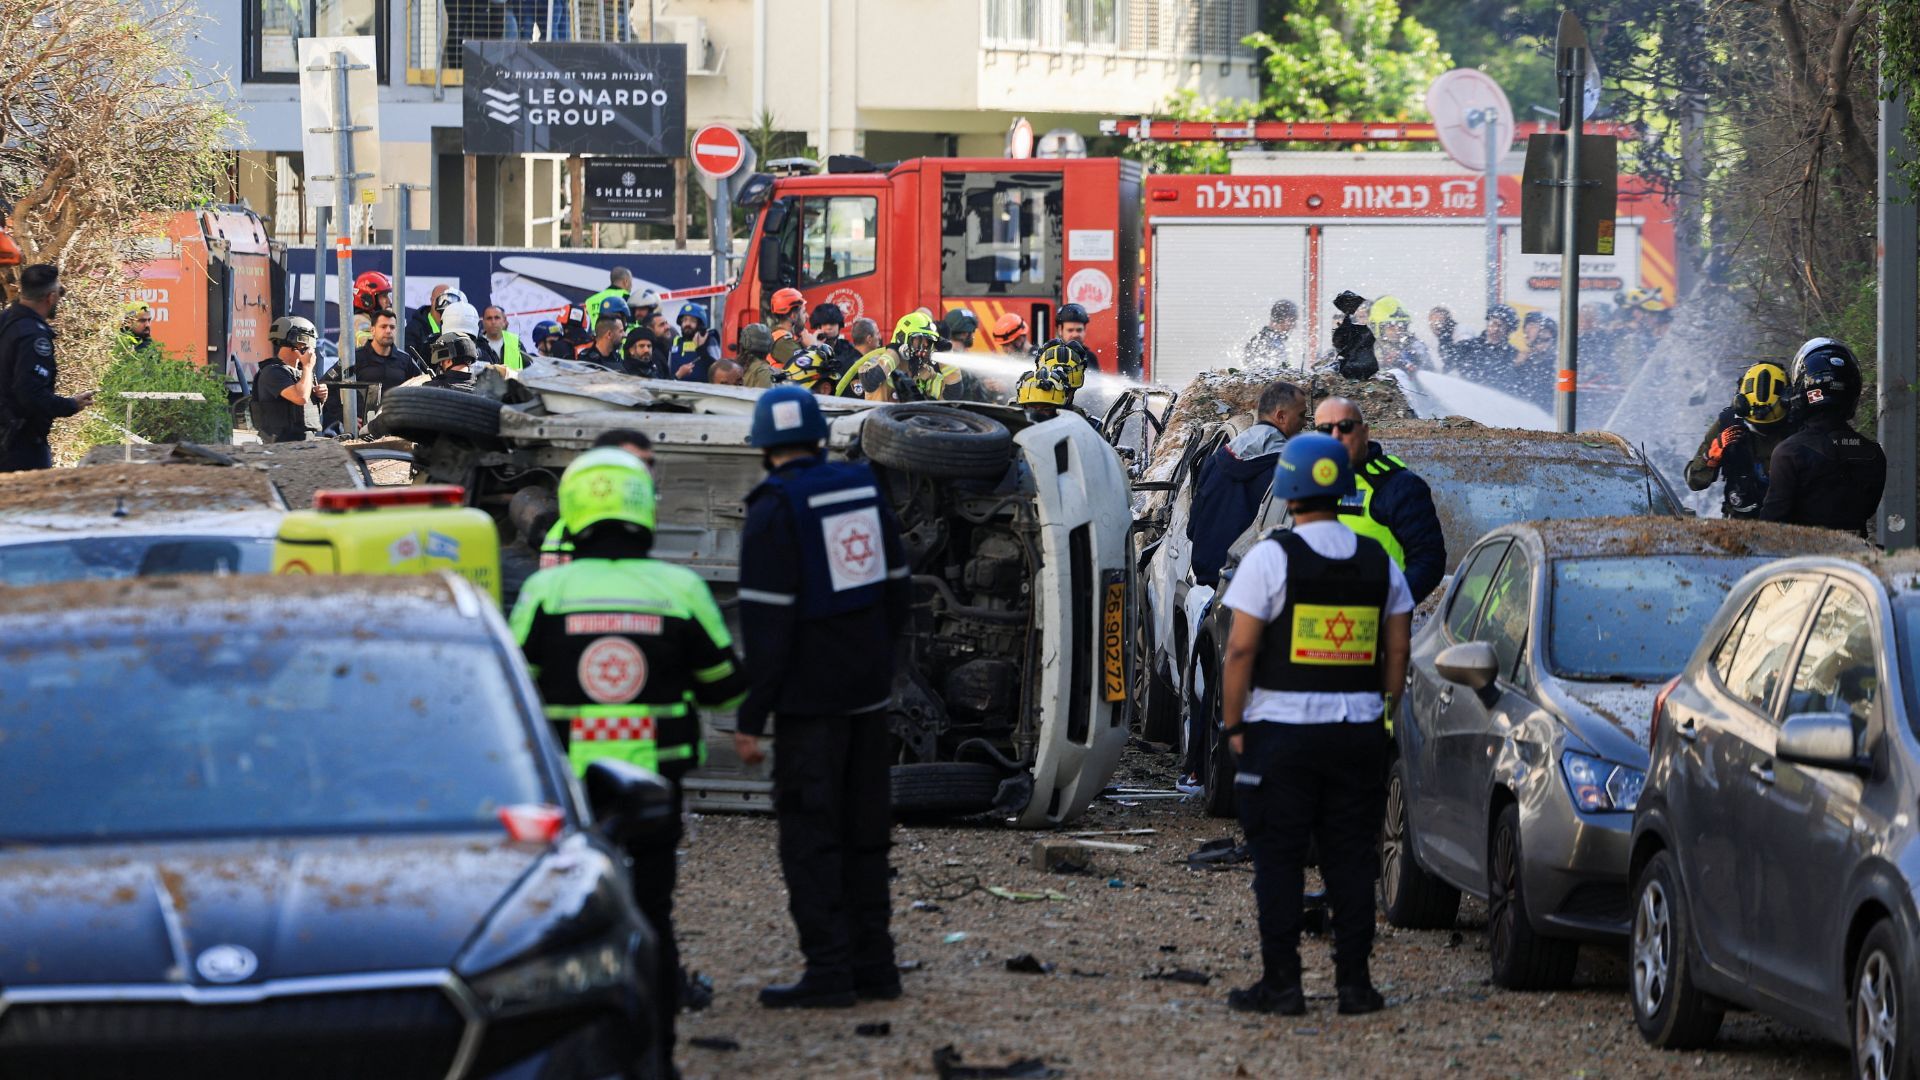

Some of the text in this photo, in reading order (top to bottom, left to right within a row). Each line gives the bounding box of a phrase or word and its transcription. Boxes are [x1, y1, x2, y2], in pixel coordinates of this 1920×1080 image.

[528, 88, 668, 106] LEONARDO
[528, 109, 616, 126] GROUP
[595, 187, 663, 198] SHEMESH
[1196, 180, 1477, 209] 102 כבאות והצלה
